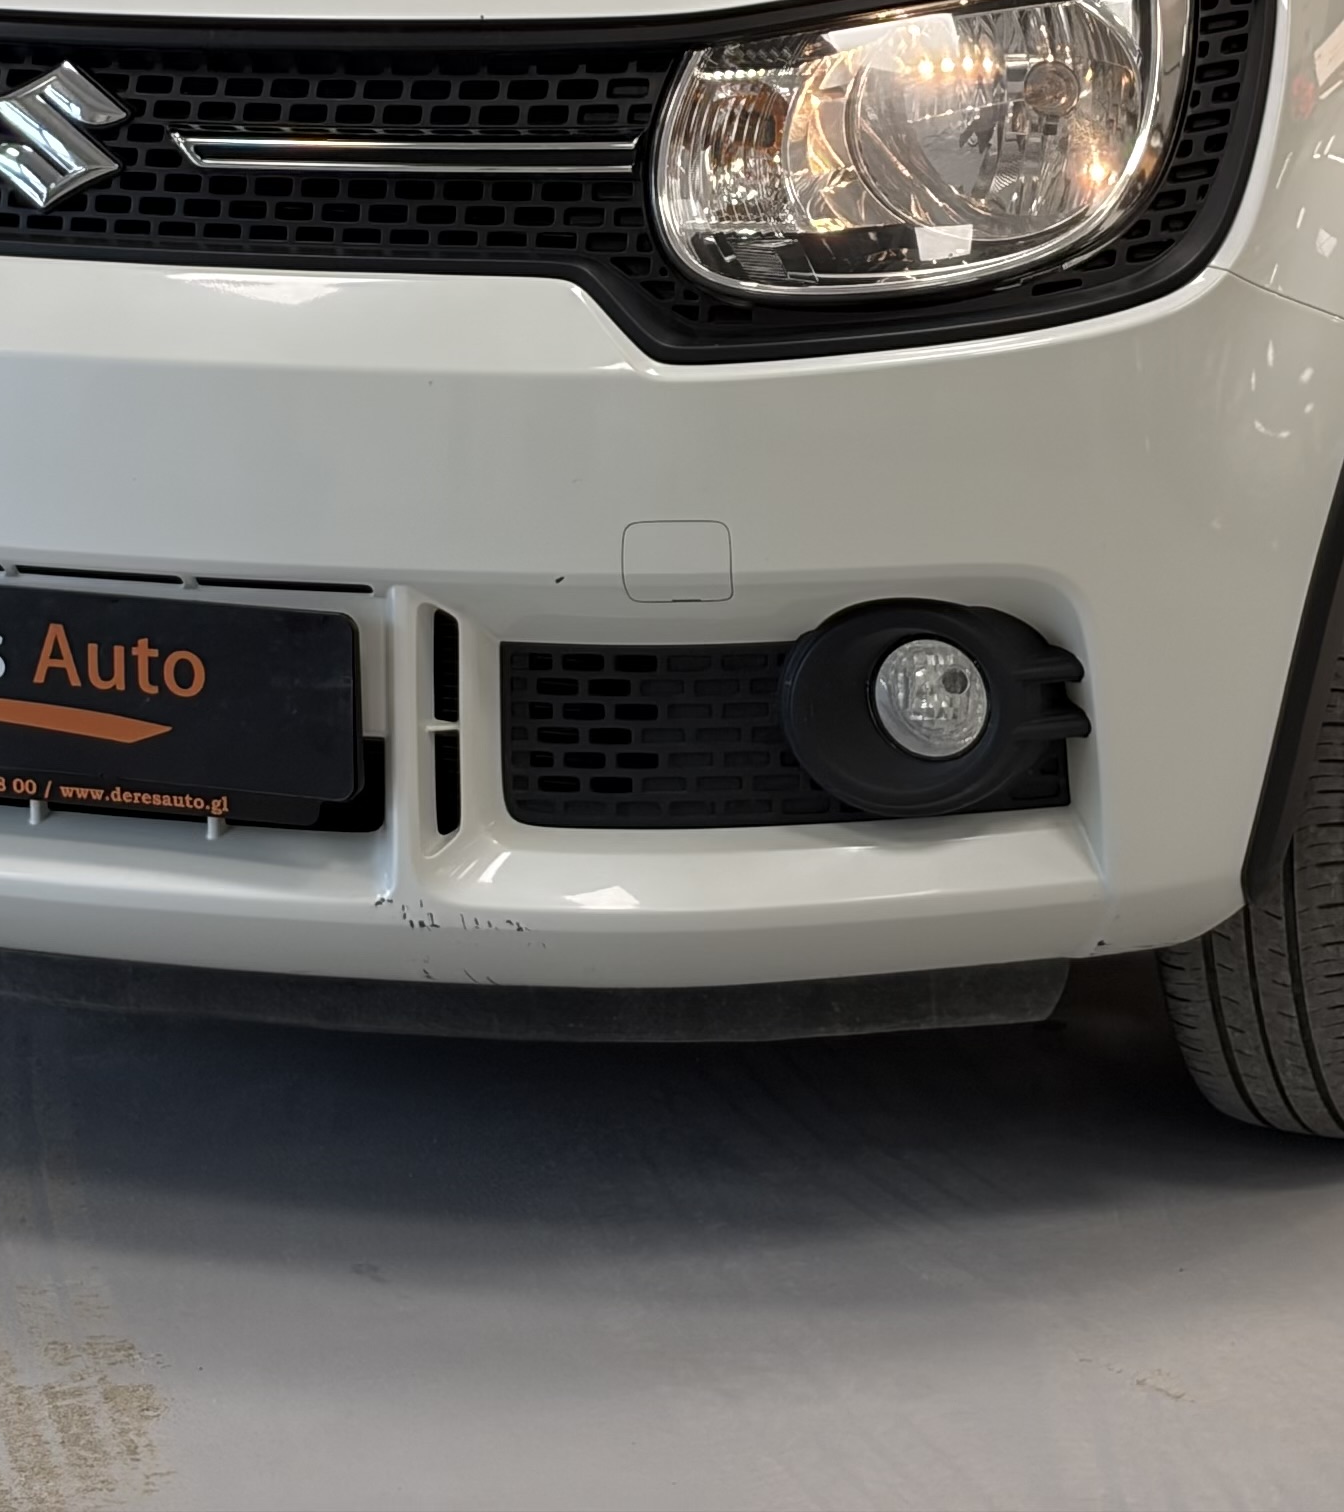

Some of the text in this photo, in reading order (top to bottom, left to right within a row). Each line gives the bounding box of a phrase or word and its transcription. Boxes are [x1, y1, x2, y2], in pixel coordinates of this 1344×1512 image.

[32, 622, 207, 699] Auto
[11, 777, 38, 796] 00
[58, 784, 230, 816] www.deresauto.gl
